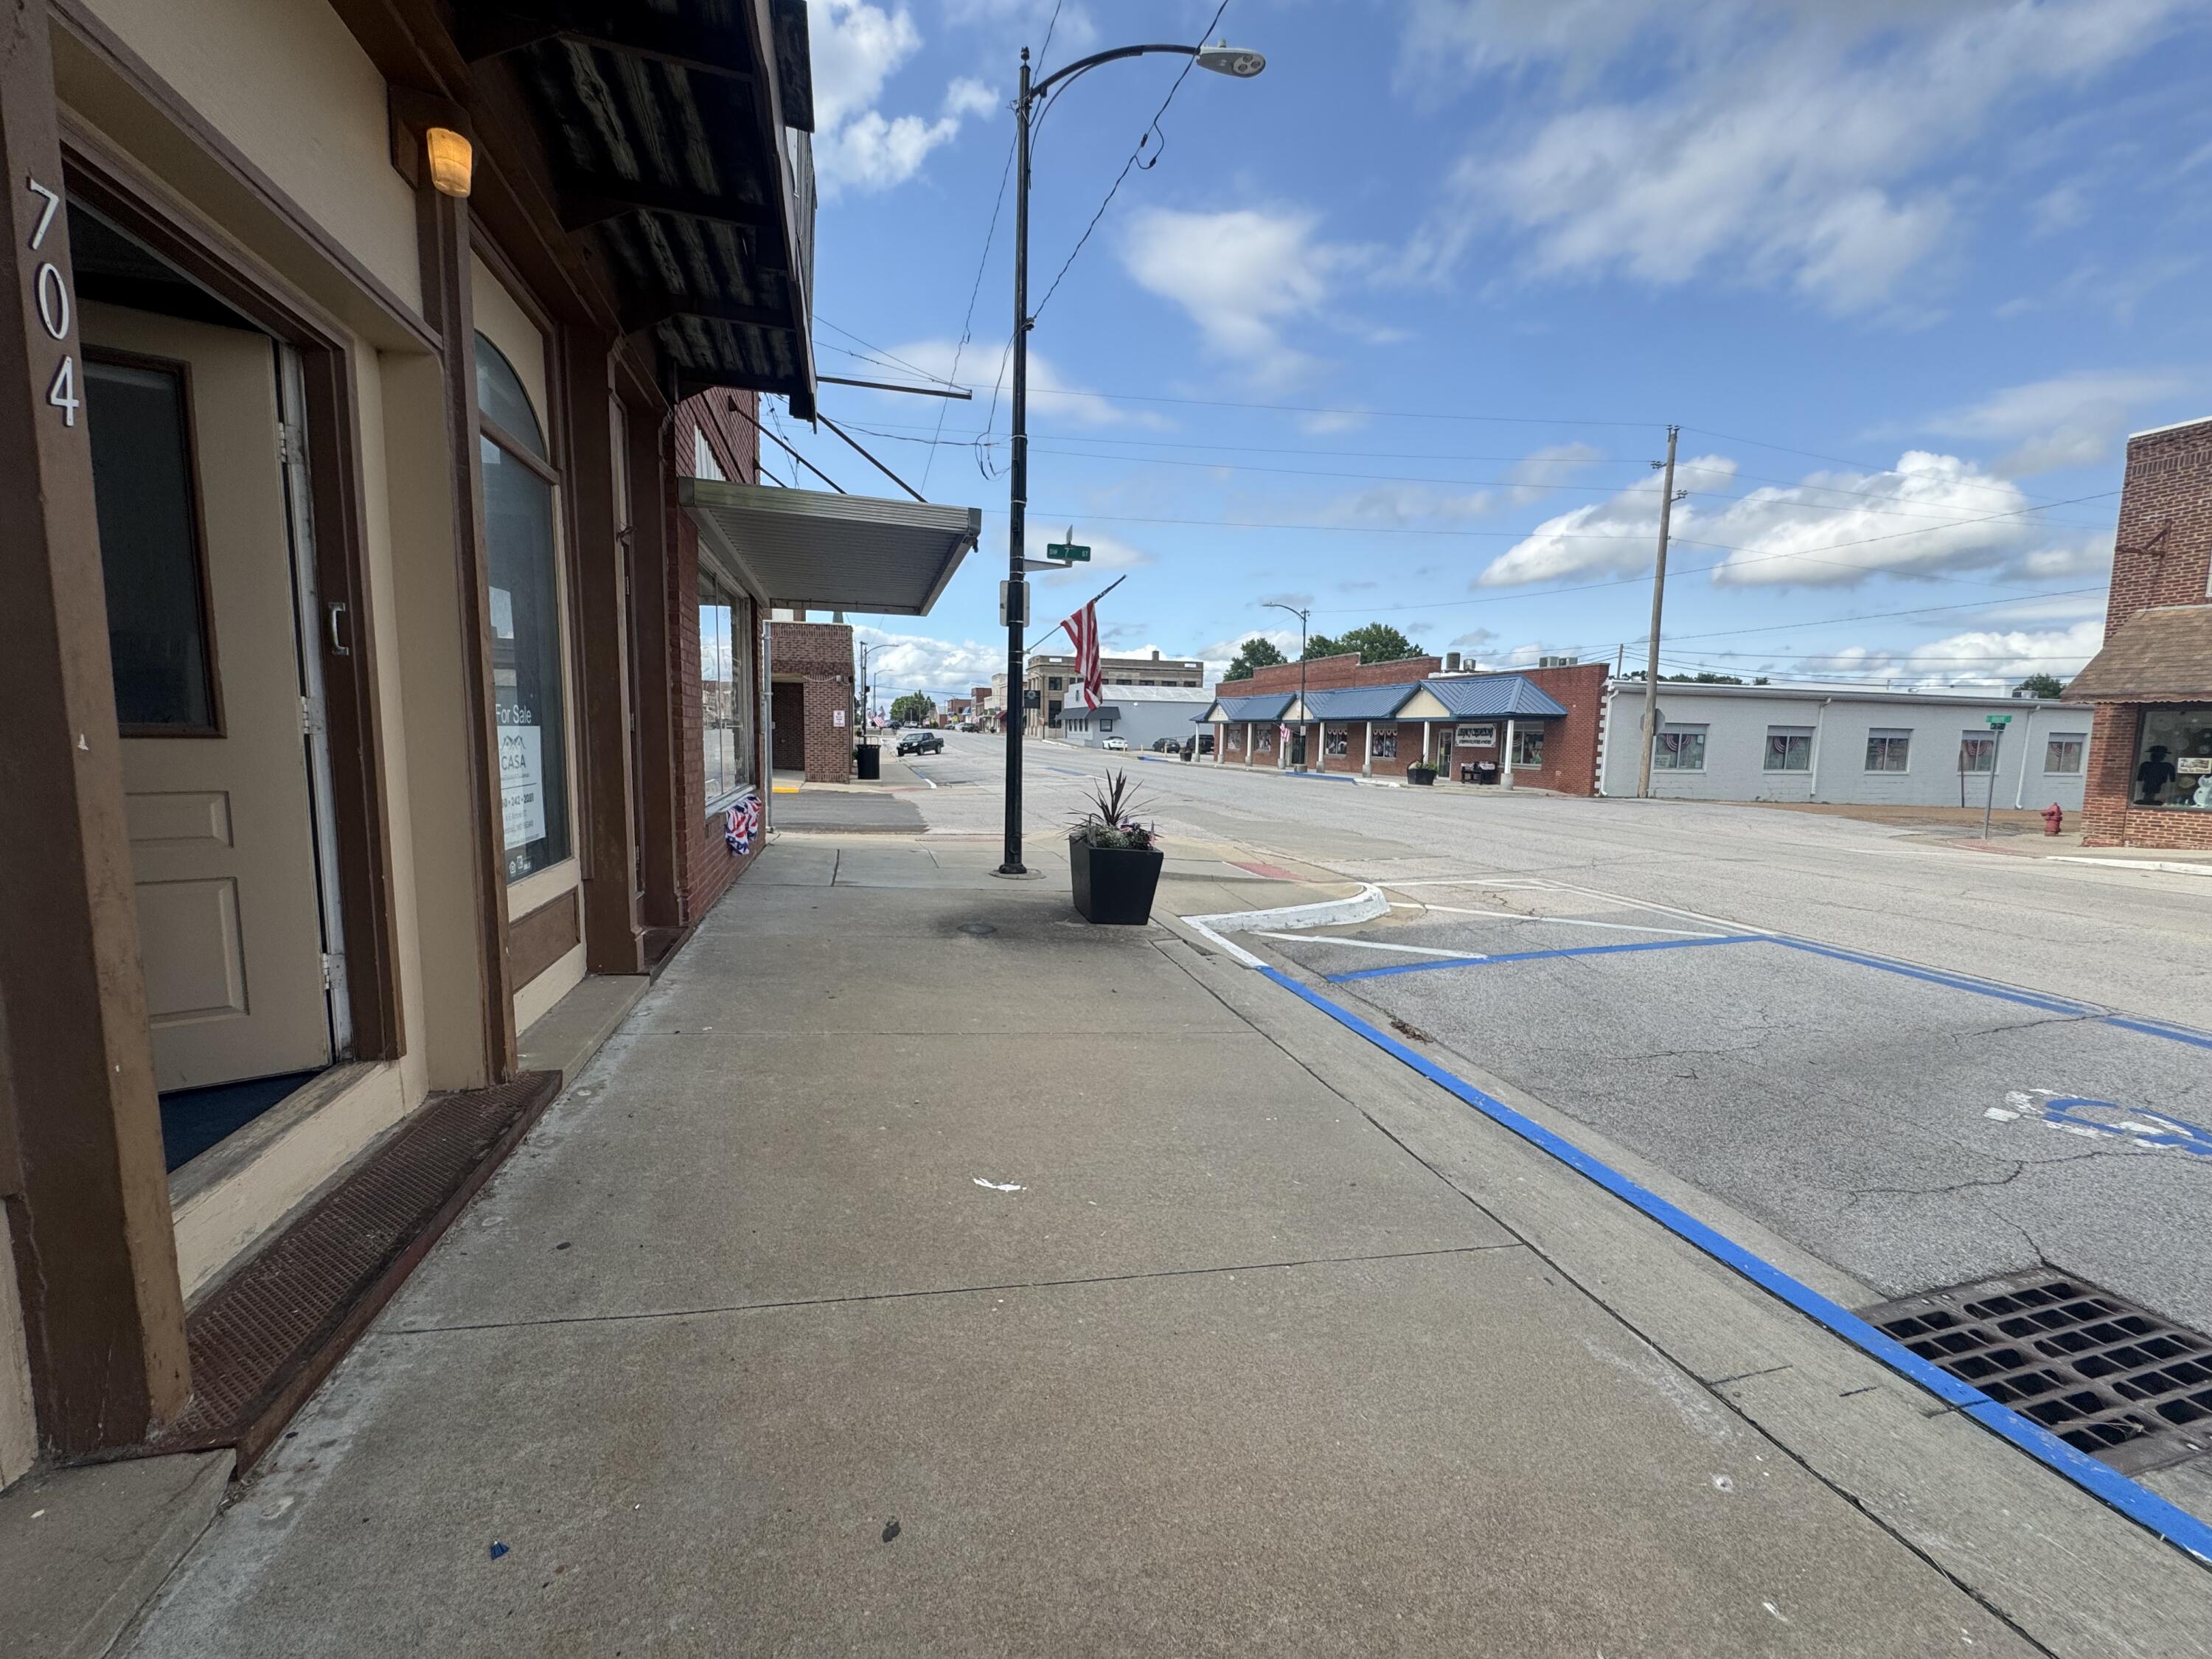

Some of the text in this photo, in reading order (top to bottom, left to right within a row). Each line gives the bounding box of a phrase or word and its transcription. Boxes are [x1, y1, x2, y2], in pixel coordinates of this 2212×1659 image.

[30, 178, 79, 424] 704
[495, 703, 532, 723] For Sale
[501, 754, 526, 770] CASA
